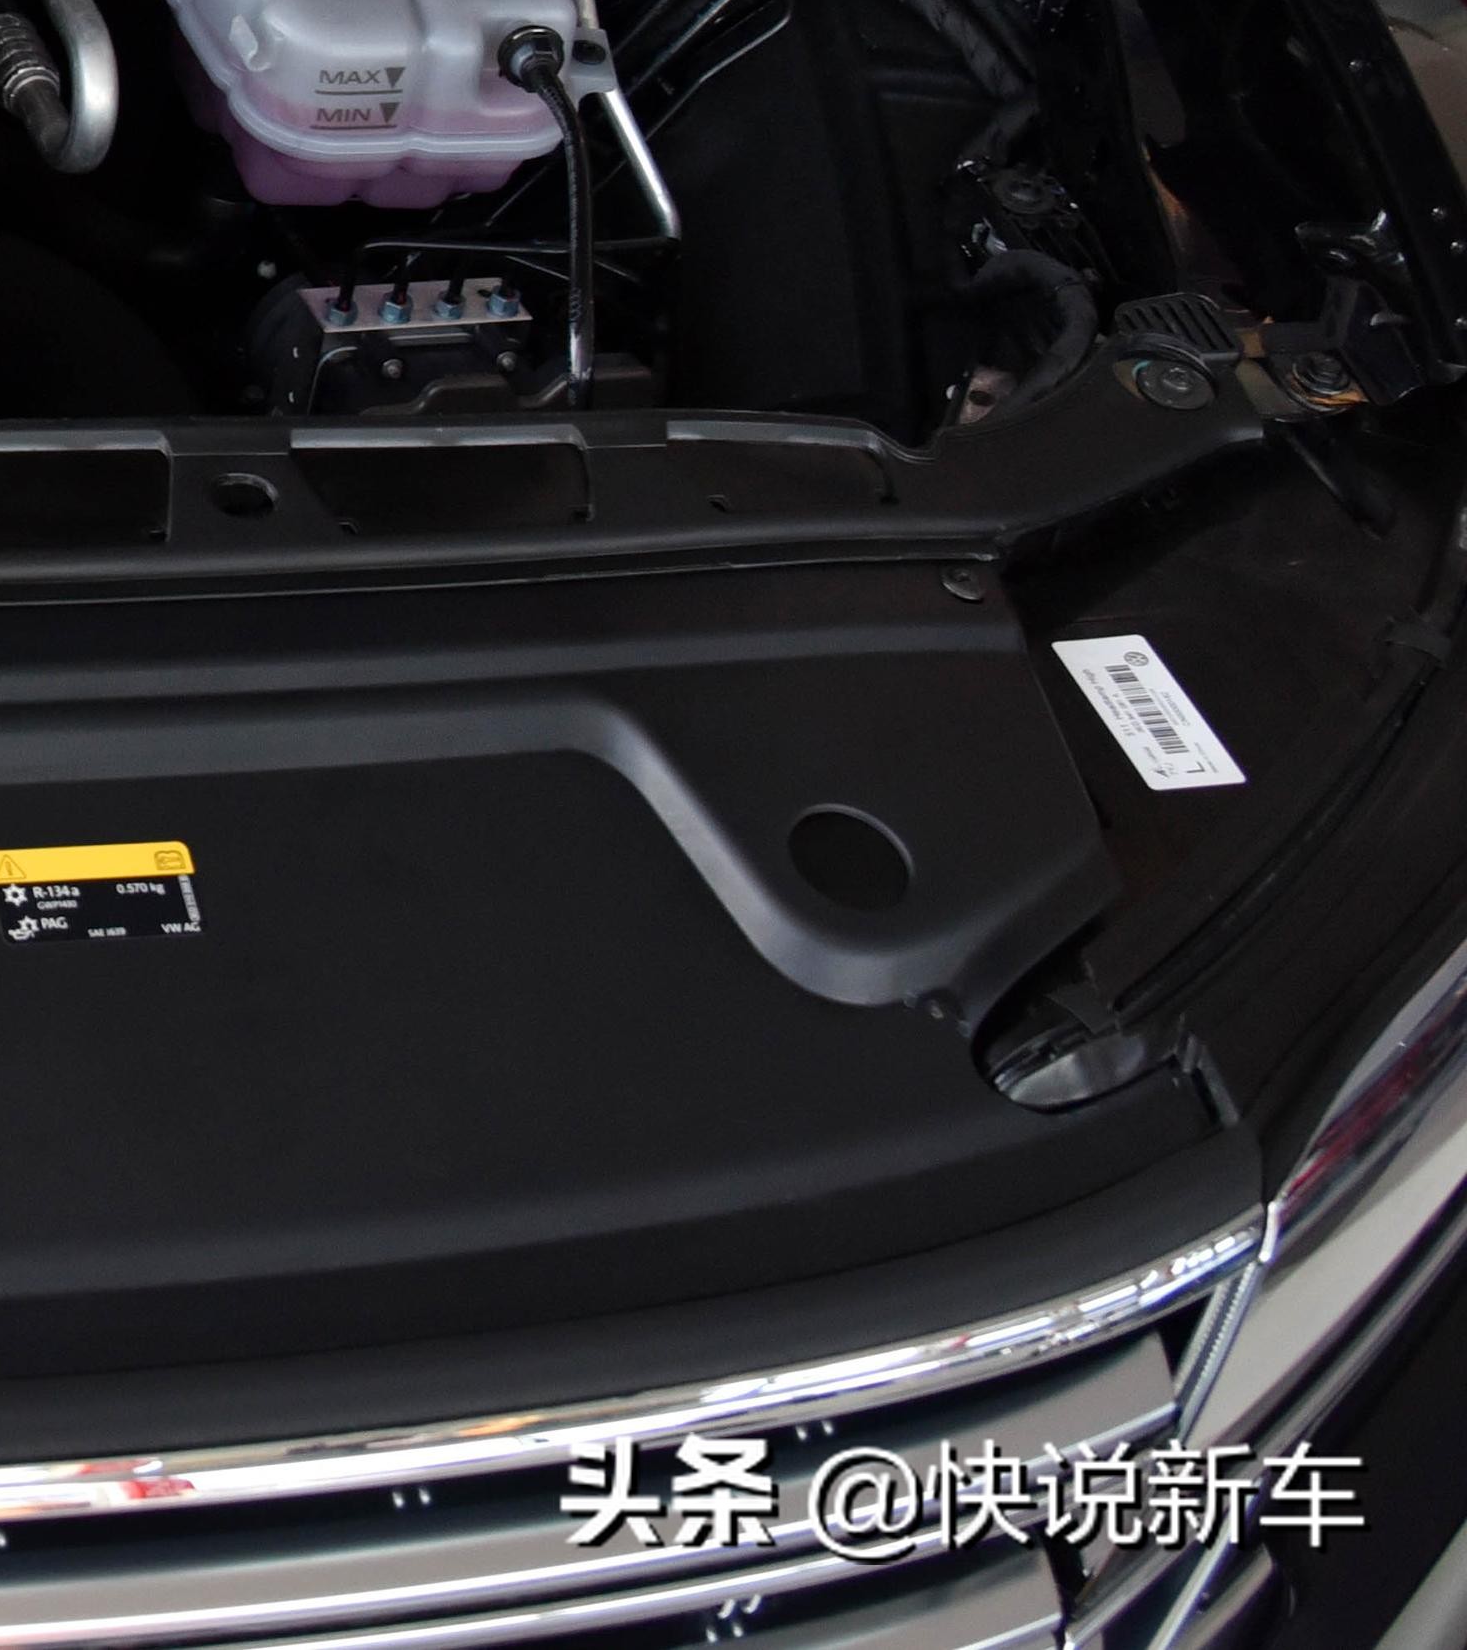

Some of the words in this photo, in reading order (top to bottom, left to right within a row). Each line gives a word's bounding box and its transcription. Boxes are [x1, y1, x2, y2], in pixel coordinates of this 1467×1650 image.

[319, 70, 381, 85] MAX
[317, 108, 371, 122] MIN
[40, 915, 69, 930] PAG
[160, 922, 182, 933] VW
[183, 921, 202, 933] AG
